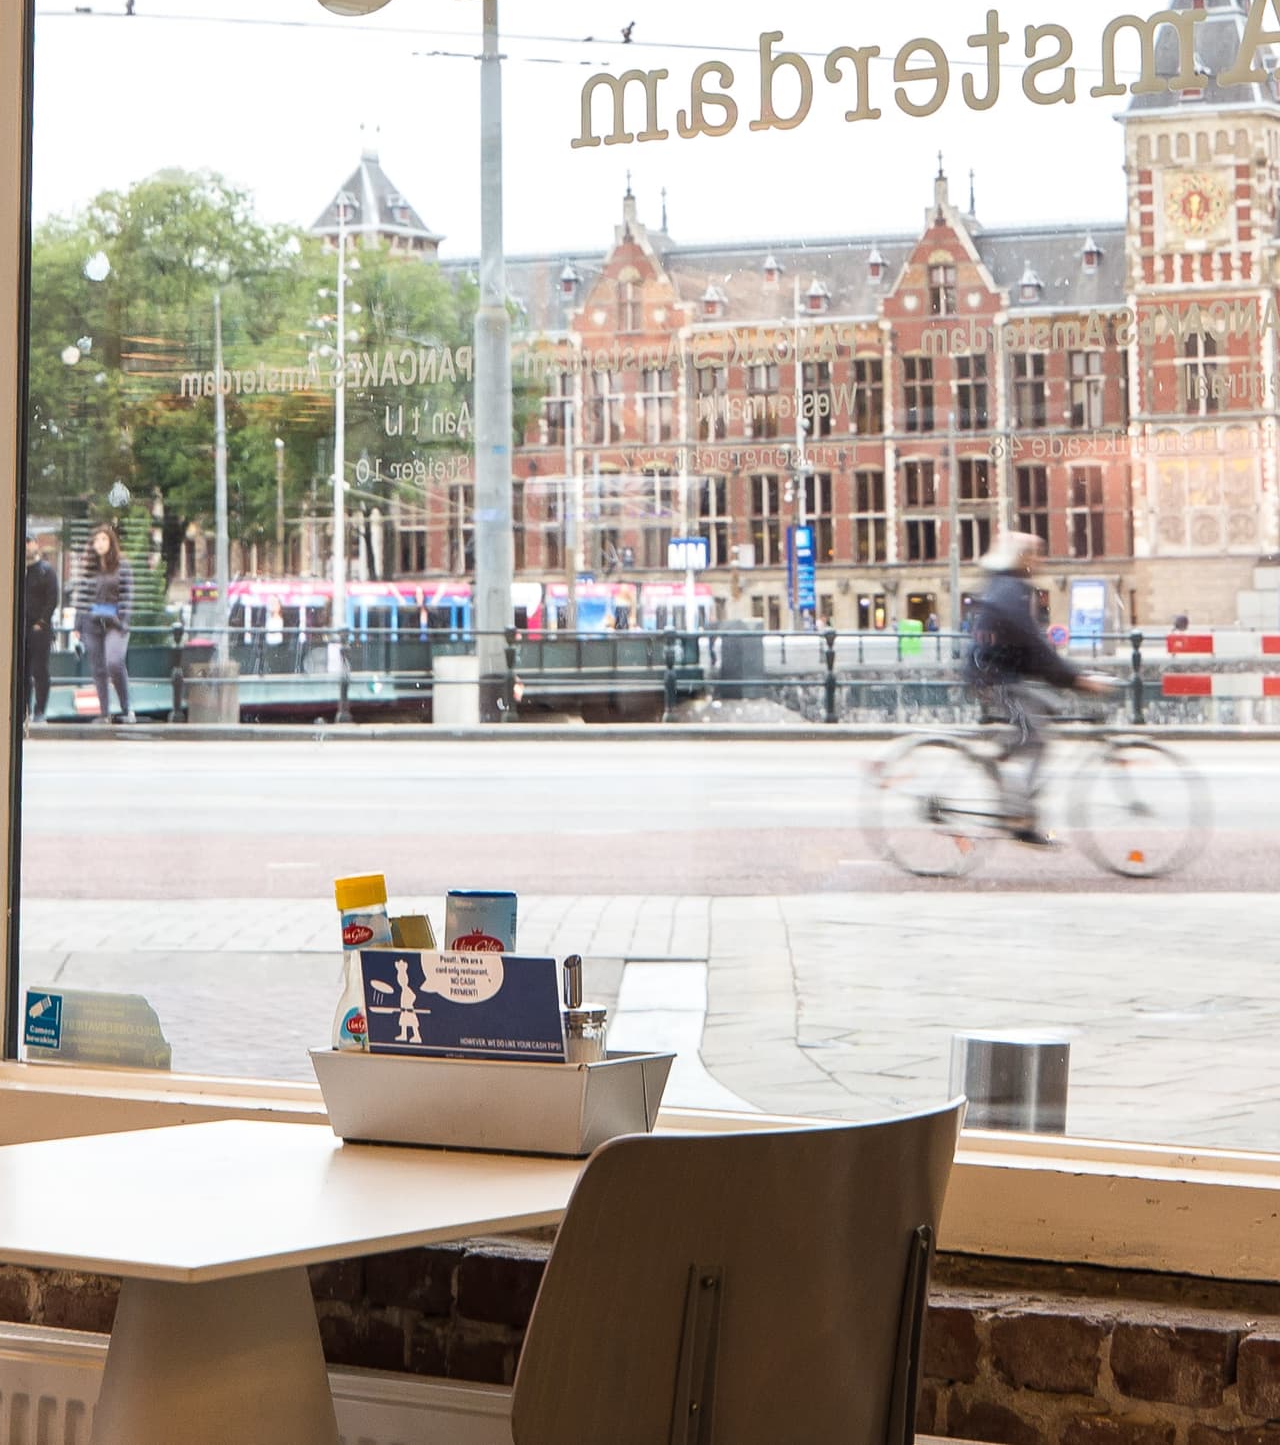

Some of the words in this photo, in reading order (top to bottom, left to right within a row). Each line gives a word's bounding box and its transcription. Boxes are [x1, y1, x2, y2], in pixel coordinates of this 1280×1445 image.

[460, 957, 469, 965] We
[436, 966, 447, 974] card
[450, 977, 459, 985] NO
[460, 978, 476, 986] CASH
[450, 987, 479, 997] PAYMENT!
[29, 1024, 55, 1036] Camera
[26, 1034, 58, 1047] bewaking
[487, 1039, 495, 1047] WE
[496, 1039, 504, 1048] DO
[517, 1040, 531, 1049] YOUR
[532, 1041, 547, 1050] CASH
